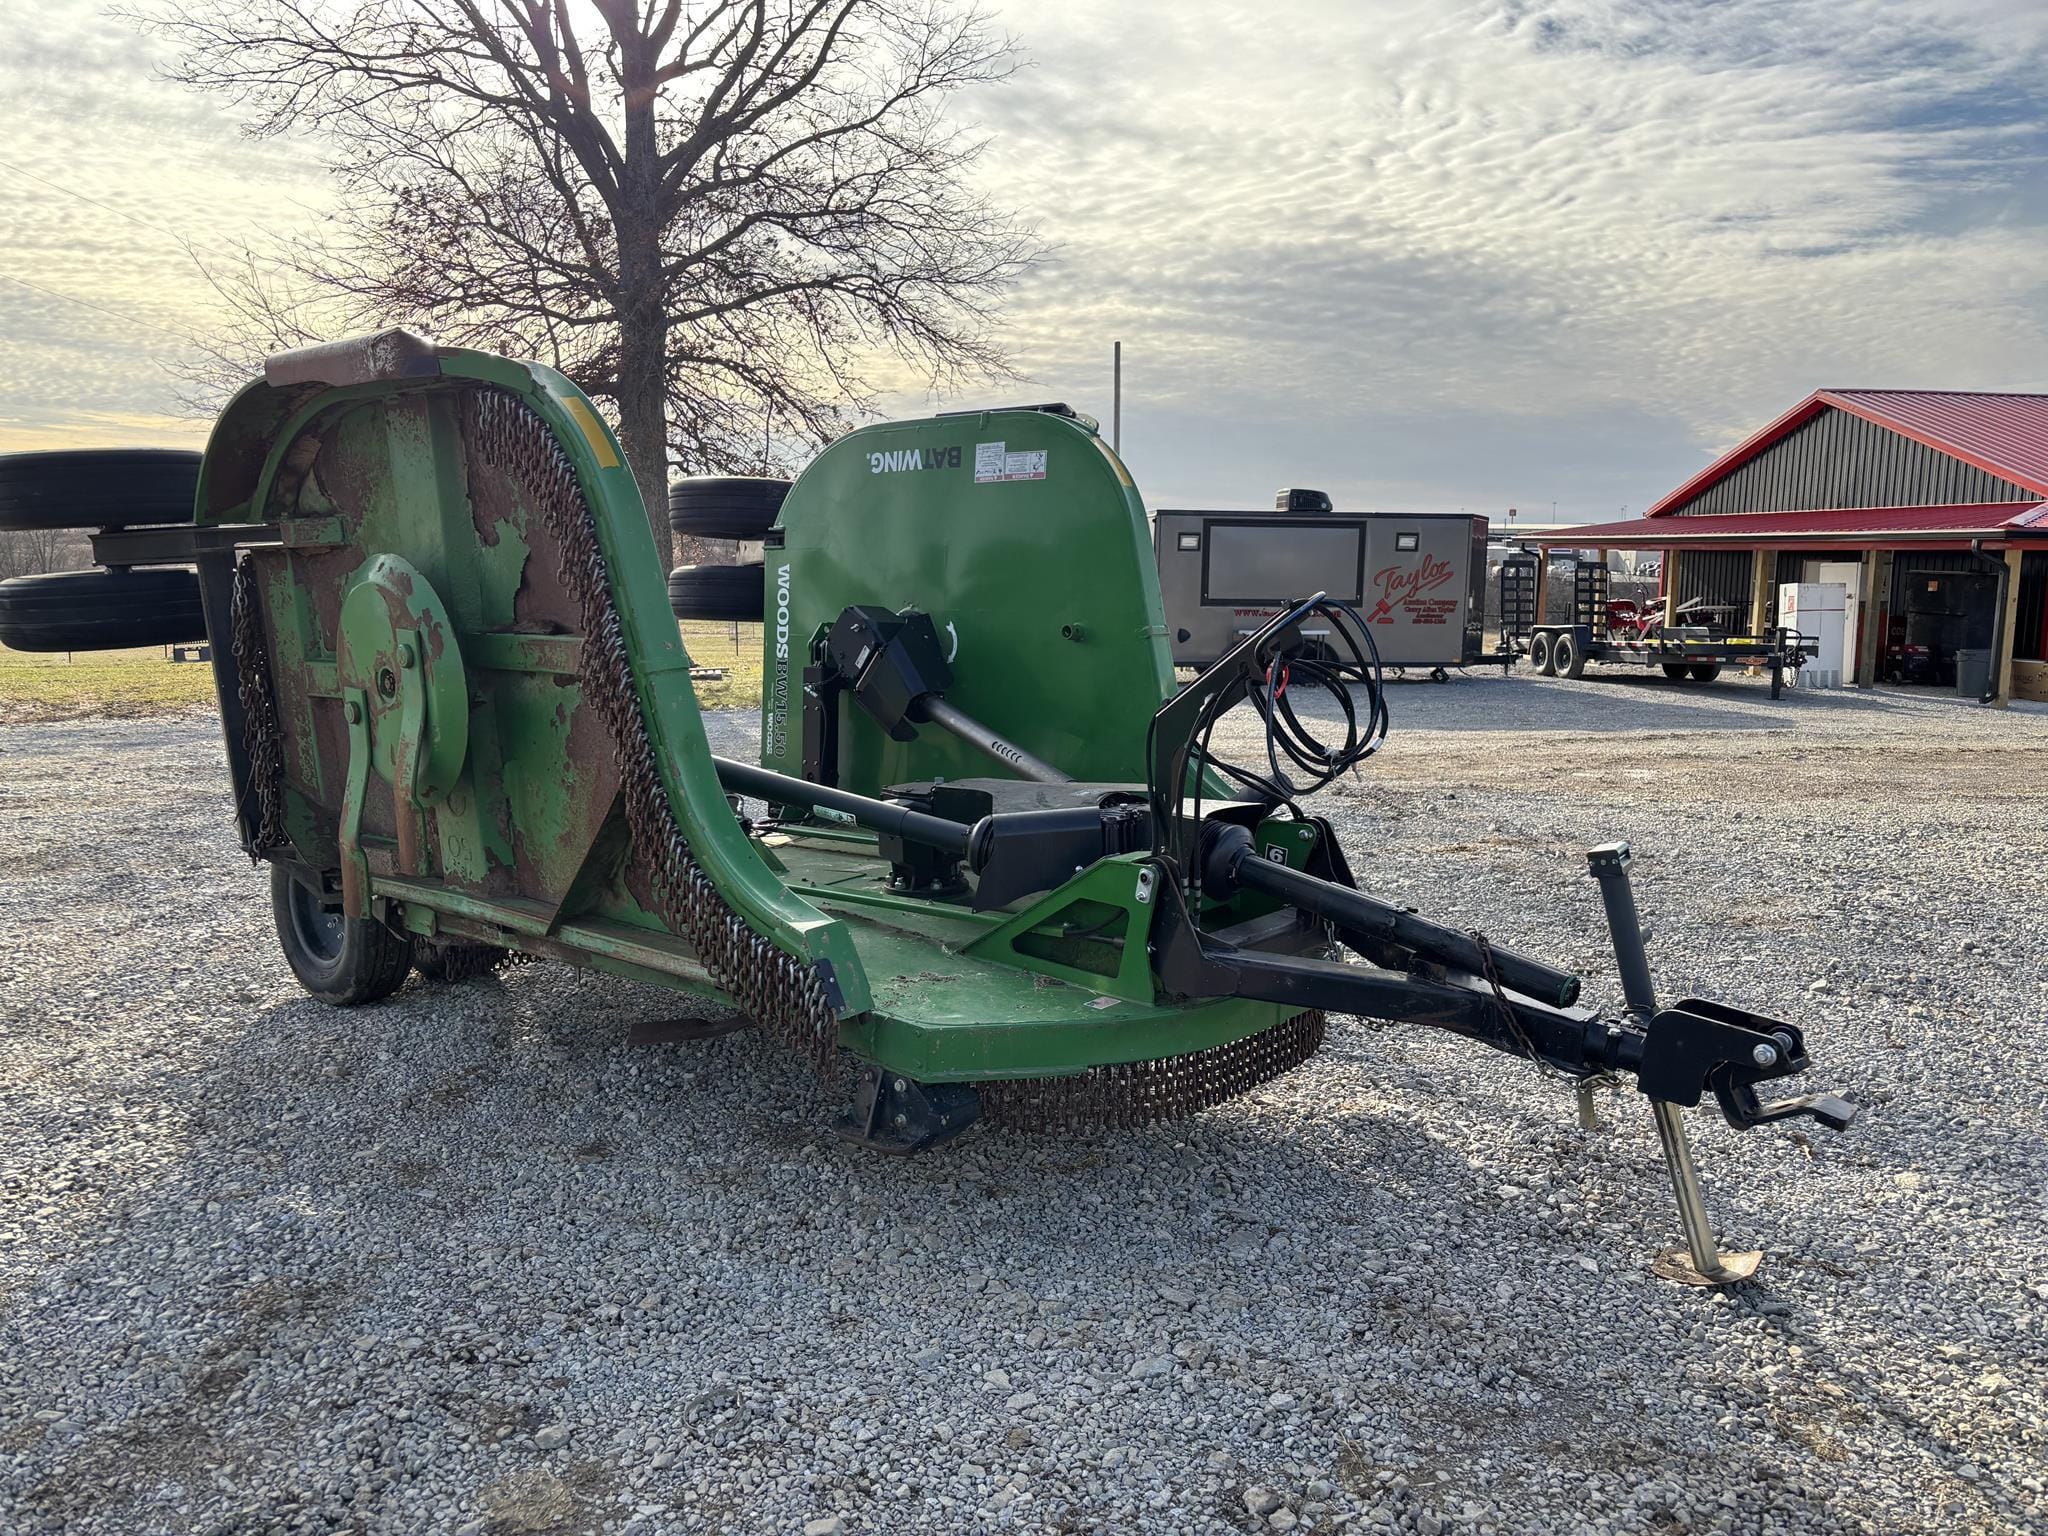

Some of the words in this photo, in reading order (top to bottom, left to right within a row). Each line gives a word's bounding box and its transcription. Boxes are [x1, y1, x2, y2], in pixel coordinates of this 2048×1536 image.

[776, 563, 790, 658] WOODS
[1374, 554, 1450, 599] Taylor
[774, 658, 789, 759] BW15.50
[1269, 848, 1284, 862] 6
